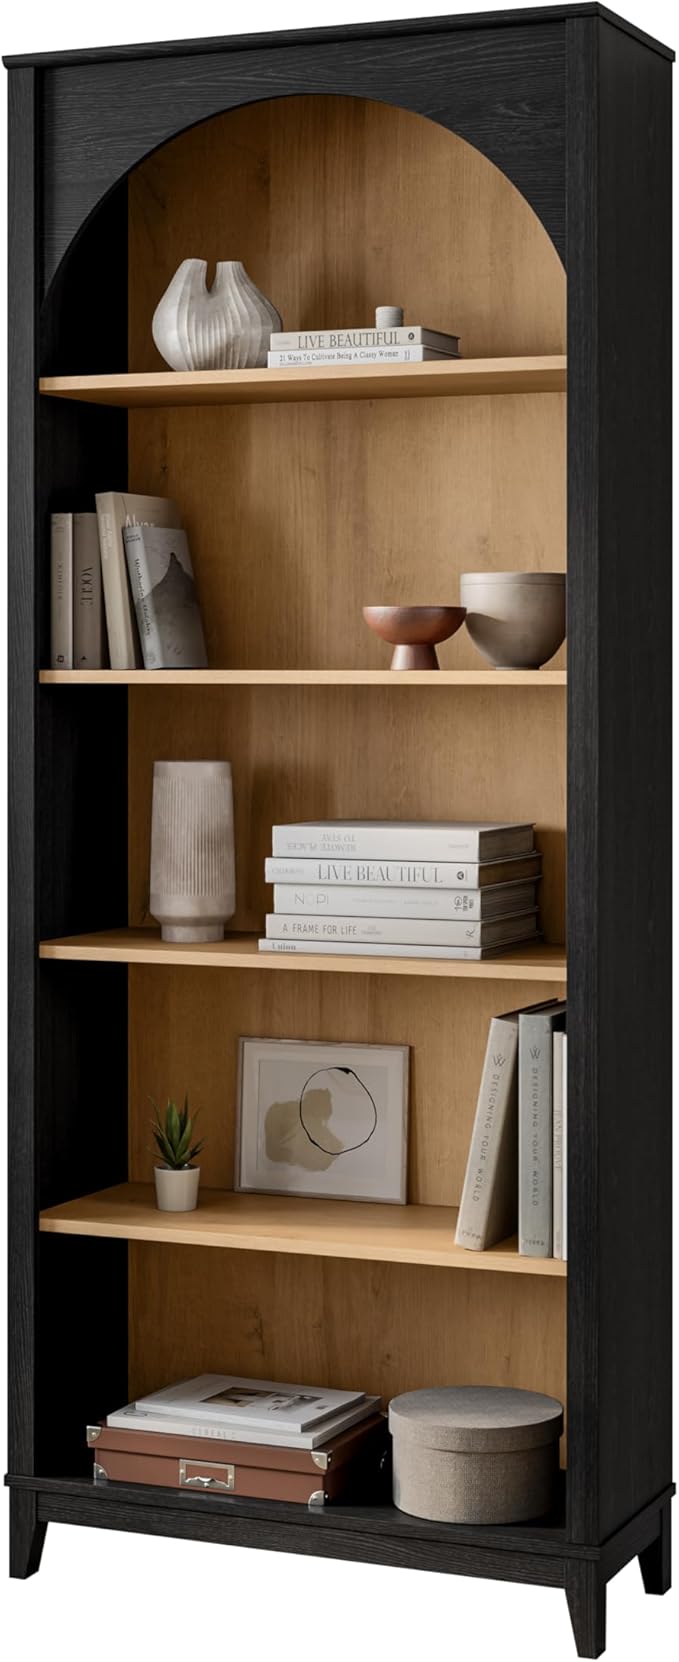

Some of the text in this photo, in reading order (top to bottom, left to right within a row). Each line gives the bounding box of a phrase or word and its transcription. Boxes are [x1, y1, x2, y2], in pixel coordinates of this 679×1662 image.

[298, 335, 324, 349] LIVE
[329, 331, 400, 348] BEAUTIFUL
[279, 354, 286, 362] 21
[288, 353, 302, 362] Ways
[304, 353, 311, 361] To
[311, 352, 336, 361] Cultivate
[336, 351, 352, 360] Being
[354, 351, 359, 359] A
[359, 350, 377, 360] Classy
[379, 349, 399, 359] Woman
[80, 567, 94, 607] VOGUE
[321, 833, 356, 842] TO STAY
[288, 842, 357, 852] REMOTE PLACES
[318, 864, 443, 884] LIVE BEAUTIFUL
[282, 923, 288, 932] A
[292, 923, 319, 934] FRAME
[323, 924, 338, 934] FOR
[341, 925, 357, 935] LIFE
[471, 1073, 500, 1202] DESIGNING YOUR WORLD
